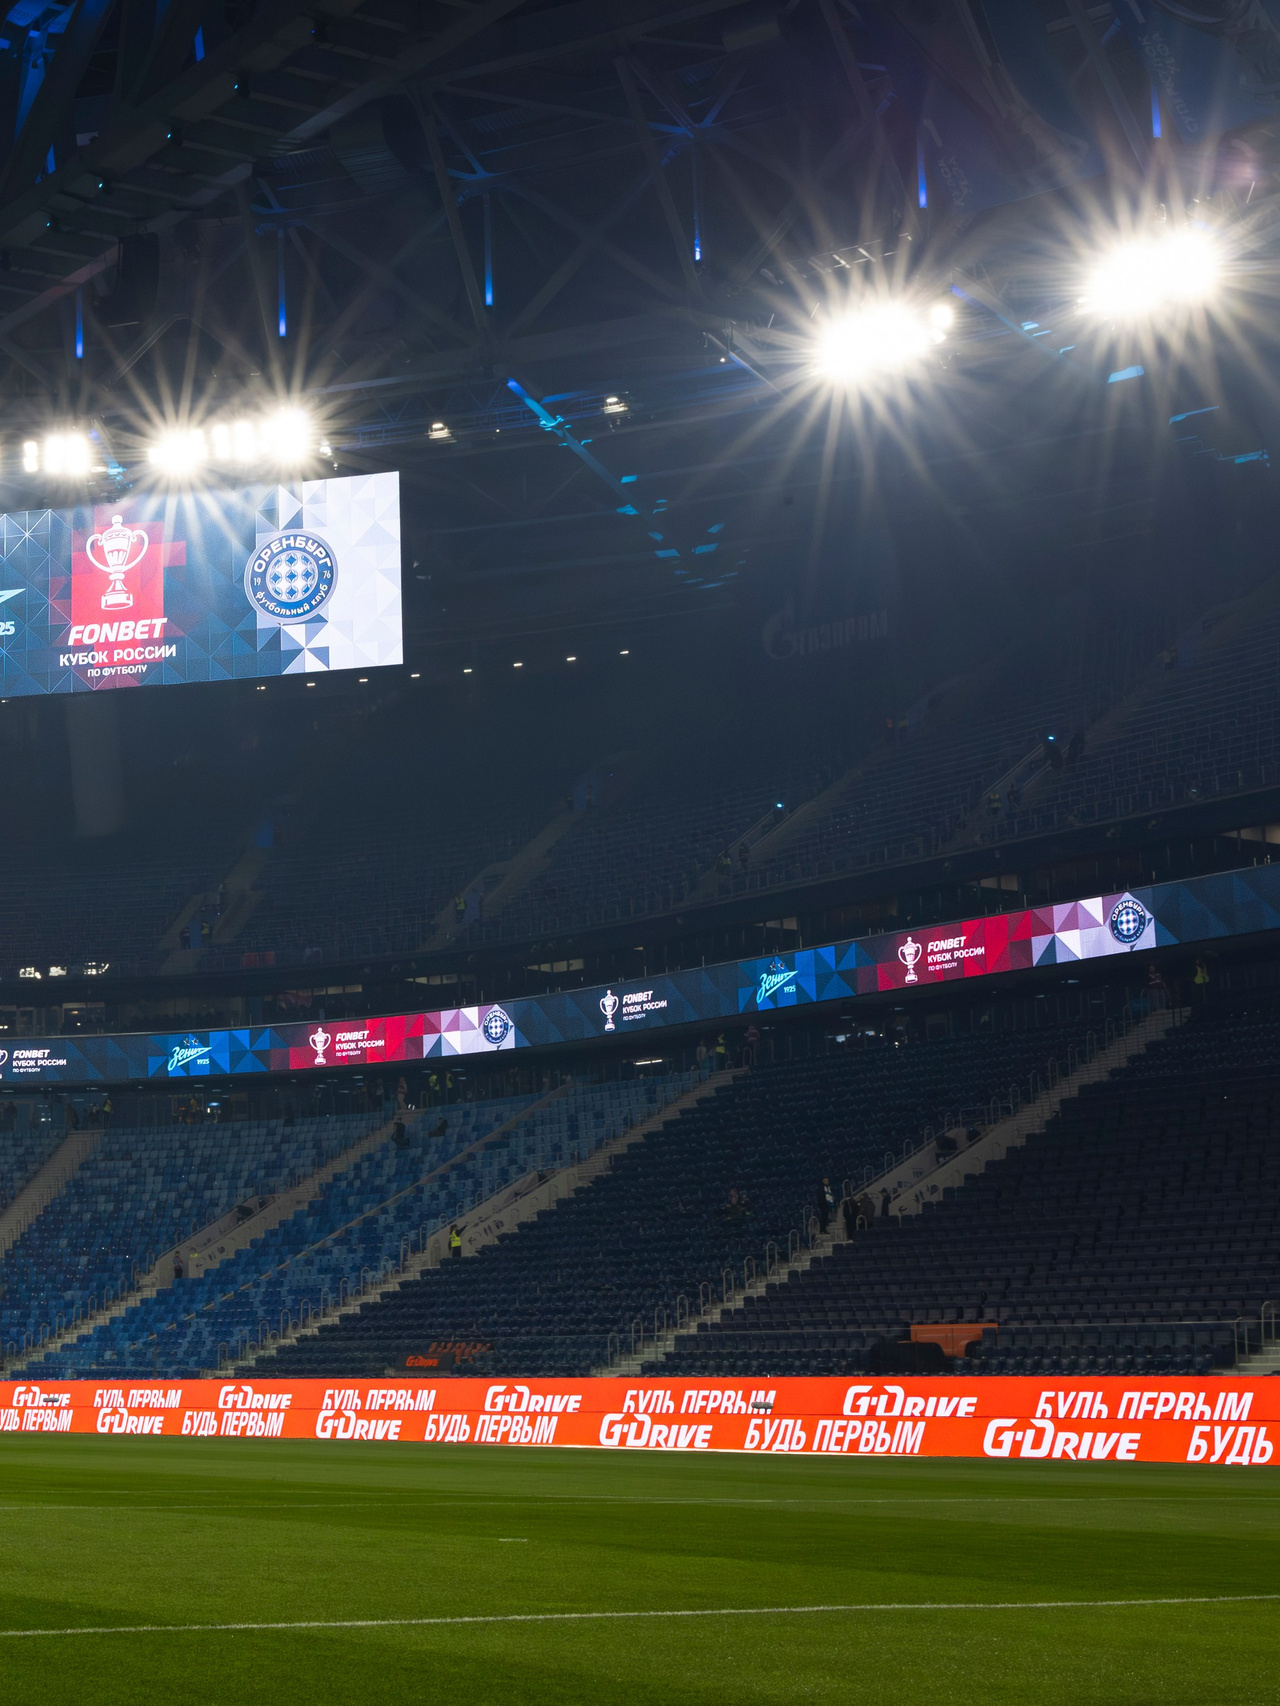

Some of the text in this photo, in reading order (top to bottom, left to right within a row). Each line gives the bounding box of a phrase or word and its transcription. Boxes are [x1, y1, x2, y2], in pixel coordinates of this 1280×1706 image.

[253, 536, 332, 573] ОРЕНБУРГ
[67, 617, 168, 646] FONBET
[59, 644, 177, 667] КУБОК РОССИИ
[87, 664, 148, 677] ПО ФУТБОЛУ
[1111, 901, 1145, 921] ОРЕНБУРГ
[927, 936, 967, 953] FONBET
[927, 946, 985, 963] КУБОК РОССИИ
[623, 991, 653, 1004] FONBET
[623, 1000, 668, 1014] КУБОК РОССИИ
[336, 1031, 370, 1042] FONBET
[336, 1040, 385, 1051] КУБОК РОССИИ
[13, 1049, 50, 1059] FONBET
[22, 1409, 74, 1432] ПЕРВЫМ
[181, 1411, 285, 1437] БУДЬ ПЕРВЫМ
[424, 1414, 558, 1444] БУДЬ ПЕРВЫМ
[744, 1418, 926, 1454] БУДЬ ПЕРВЫМ
[1187, 1426, 1275, 1466] БУДЬ
